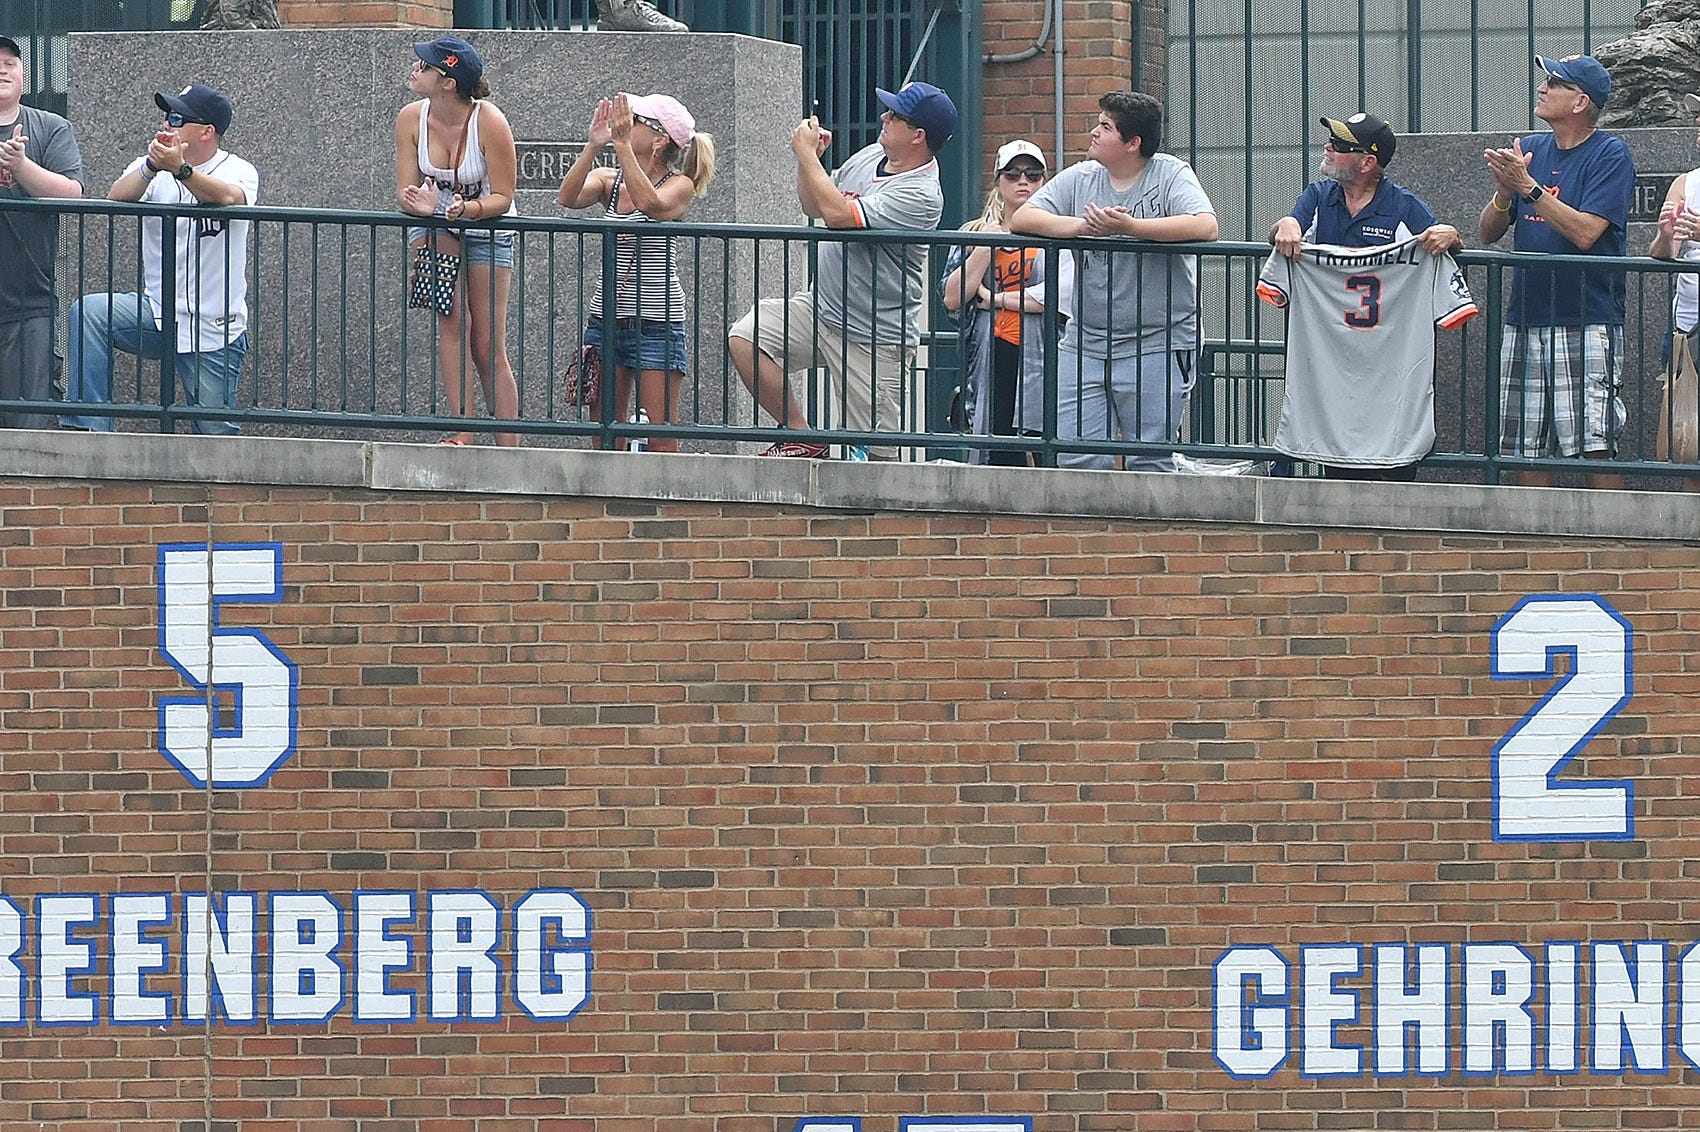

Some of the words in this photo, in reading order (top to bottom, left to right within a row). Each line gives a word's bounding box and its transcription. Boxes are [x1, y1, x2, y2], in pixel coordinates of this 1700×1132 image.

[1344, 274, 1382, 330] 3
[158, 542, 298, 789] 5
[1490, 593, 1635, 843] 2
